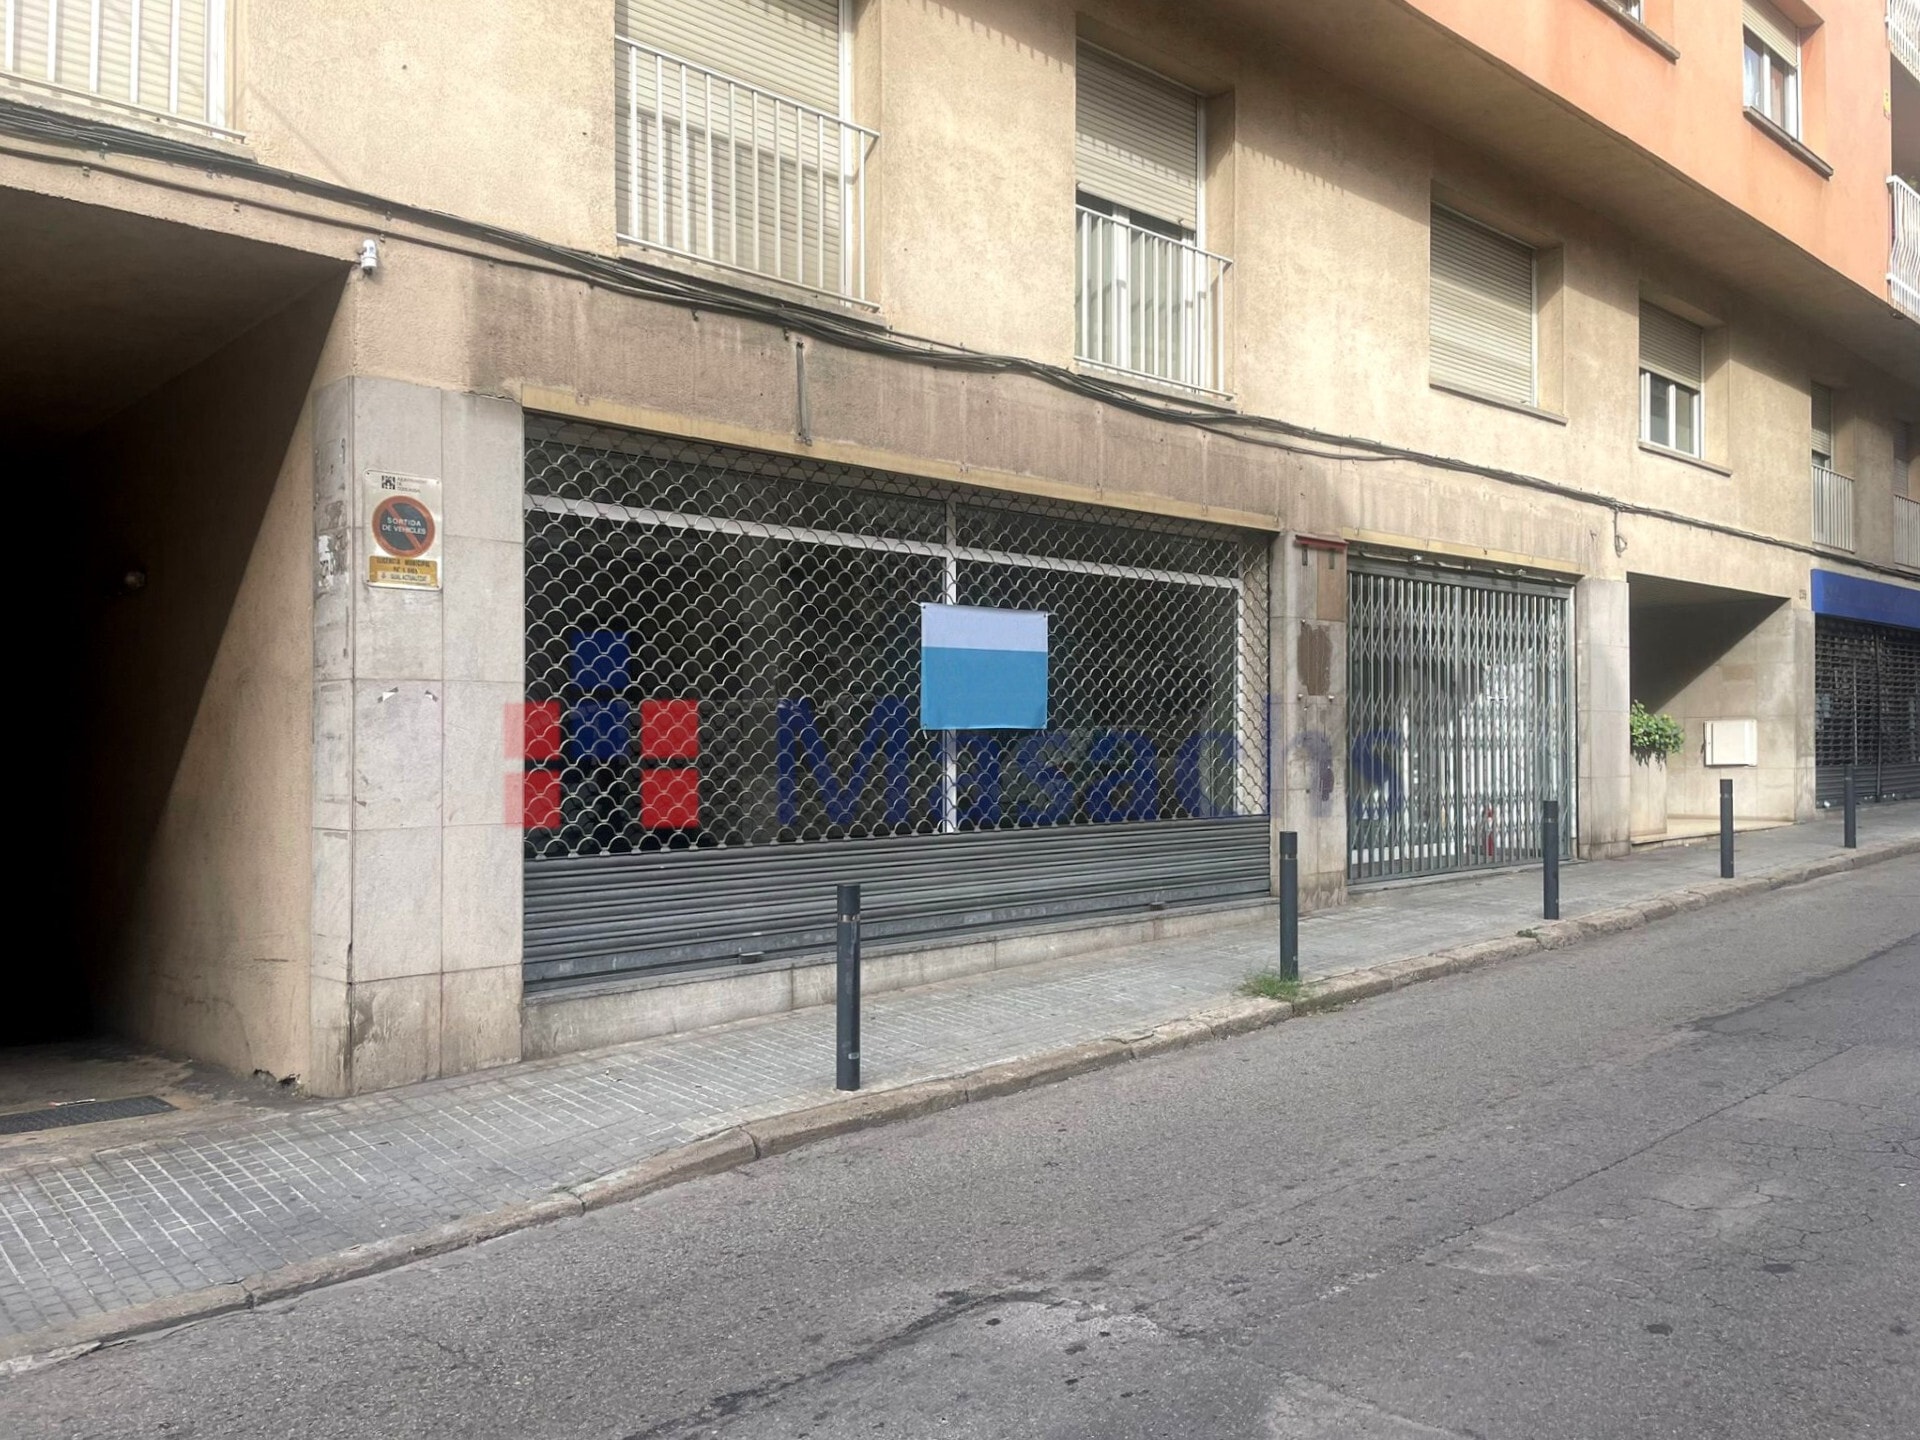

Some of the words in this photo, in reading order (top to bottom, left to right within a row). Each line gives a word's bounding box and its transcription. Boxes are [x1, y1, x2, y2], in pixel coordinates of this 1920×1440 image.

[387, 516, 421, 527] SORTIDA
[382, 524, 392, 532] DE
[393, 526, 426, 535] VEHICLES
